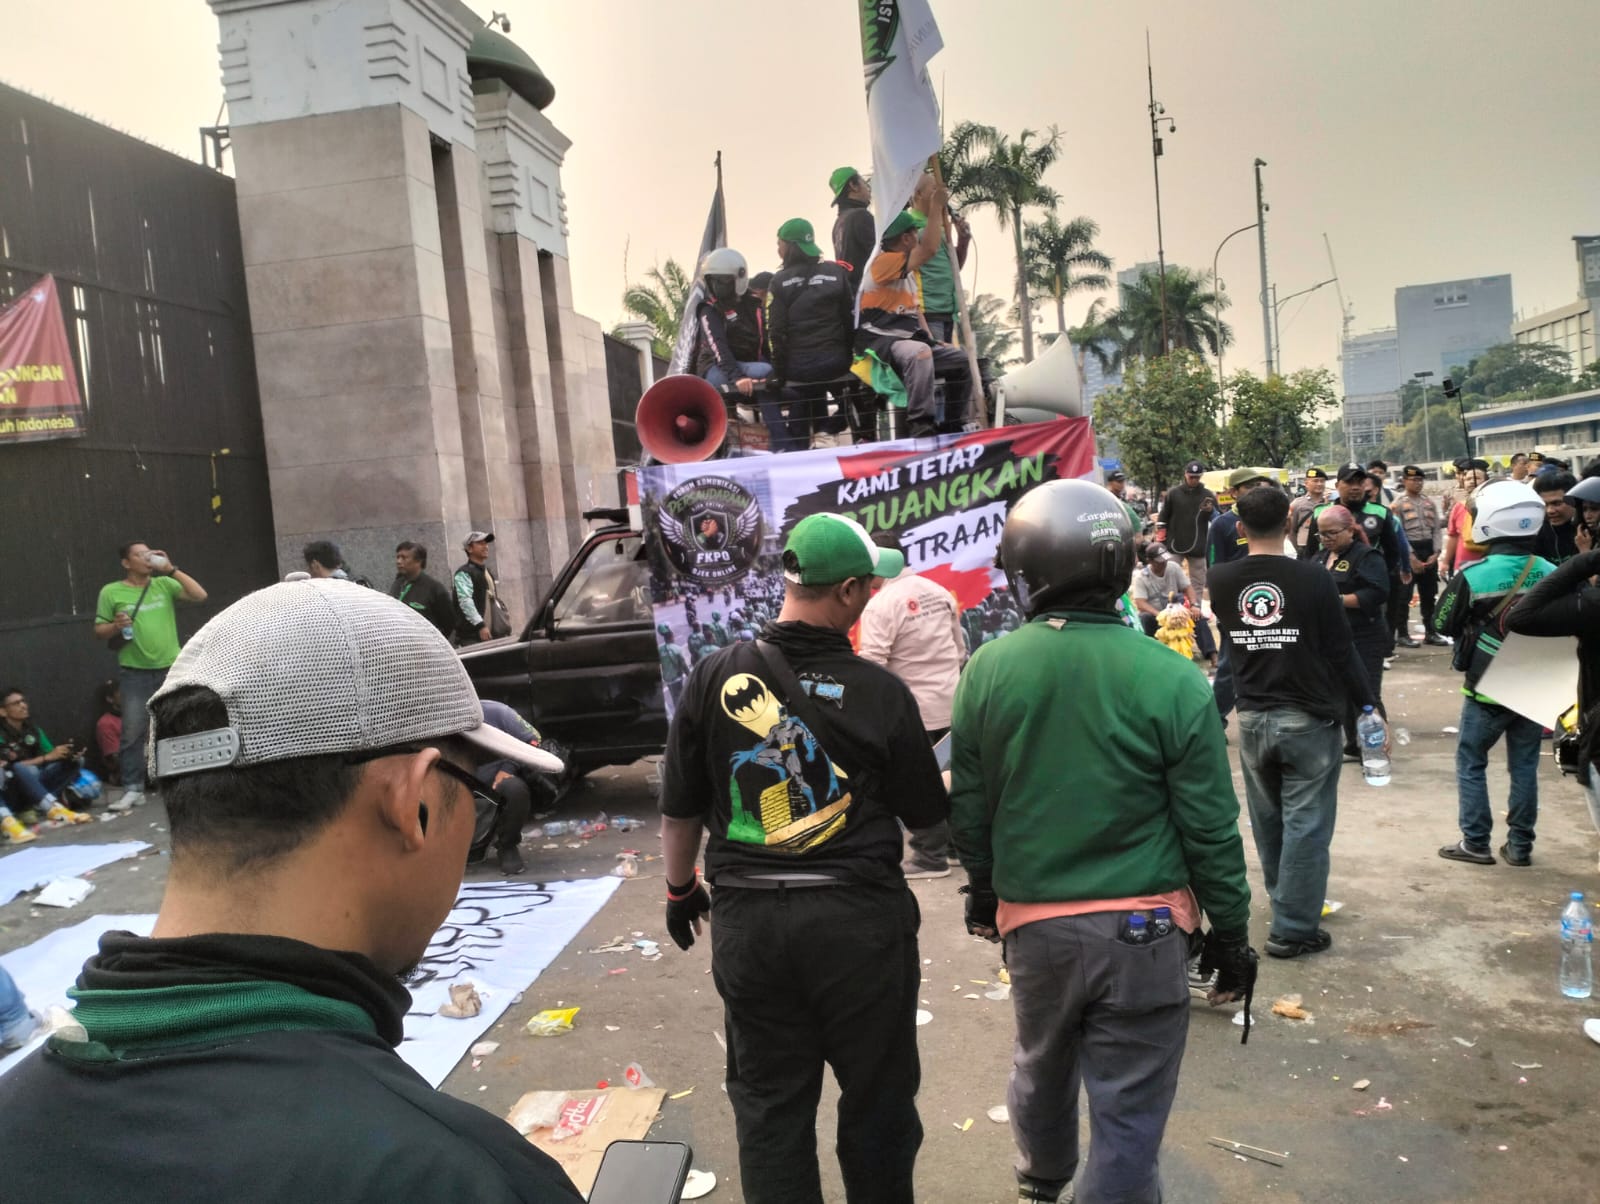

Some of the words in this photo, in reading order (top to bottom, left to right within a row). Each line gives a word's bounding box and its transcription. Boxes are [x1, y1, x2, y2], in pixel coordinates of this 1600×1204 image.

[15, 414, 74, 432] Indonesia
[837, 467, 901, 505] KAMI
[906, 444, 985, 485] TETAP
[842, 450, 1045, 535] JUANGKAN
[901, 513, 1004, 567] ITRAAN
[712, 564, 738, 578] ONLINE
